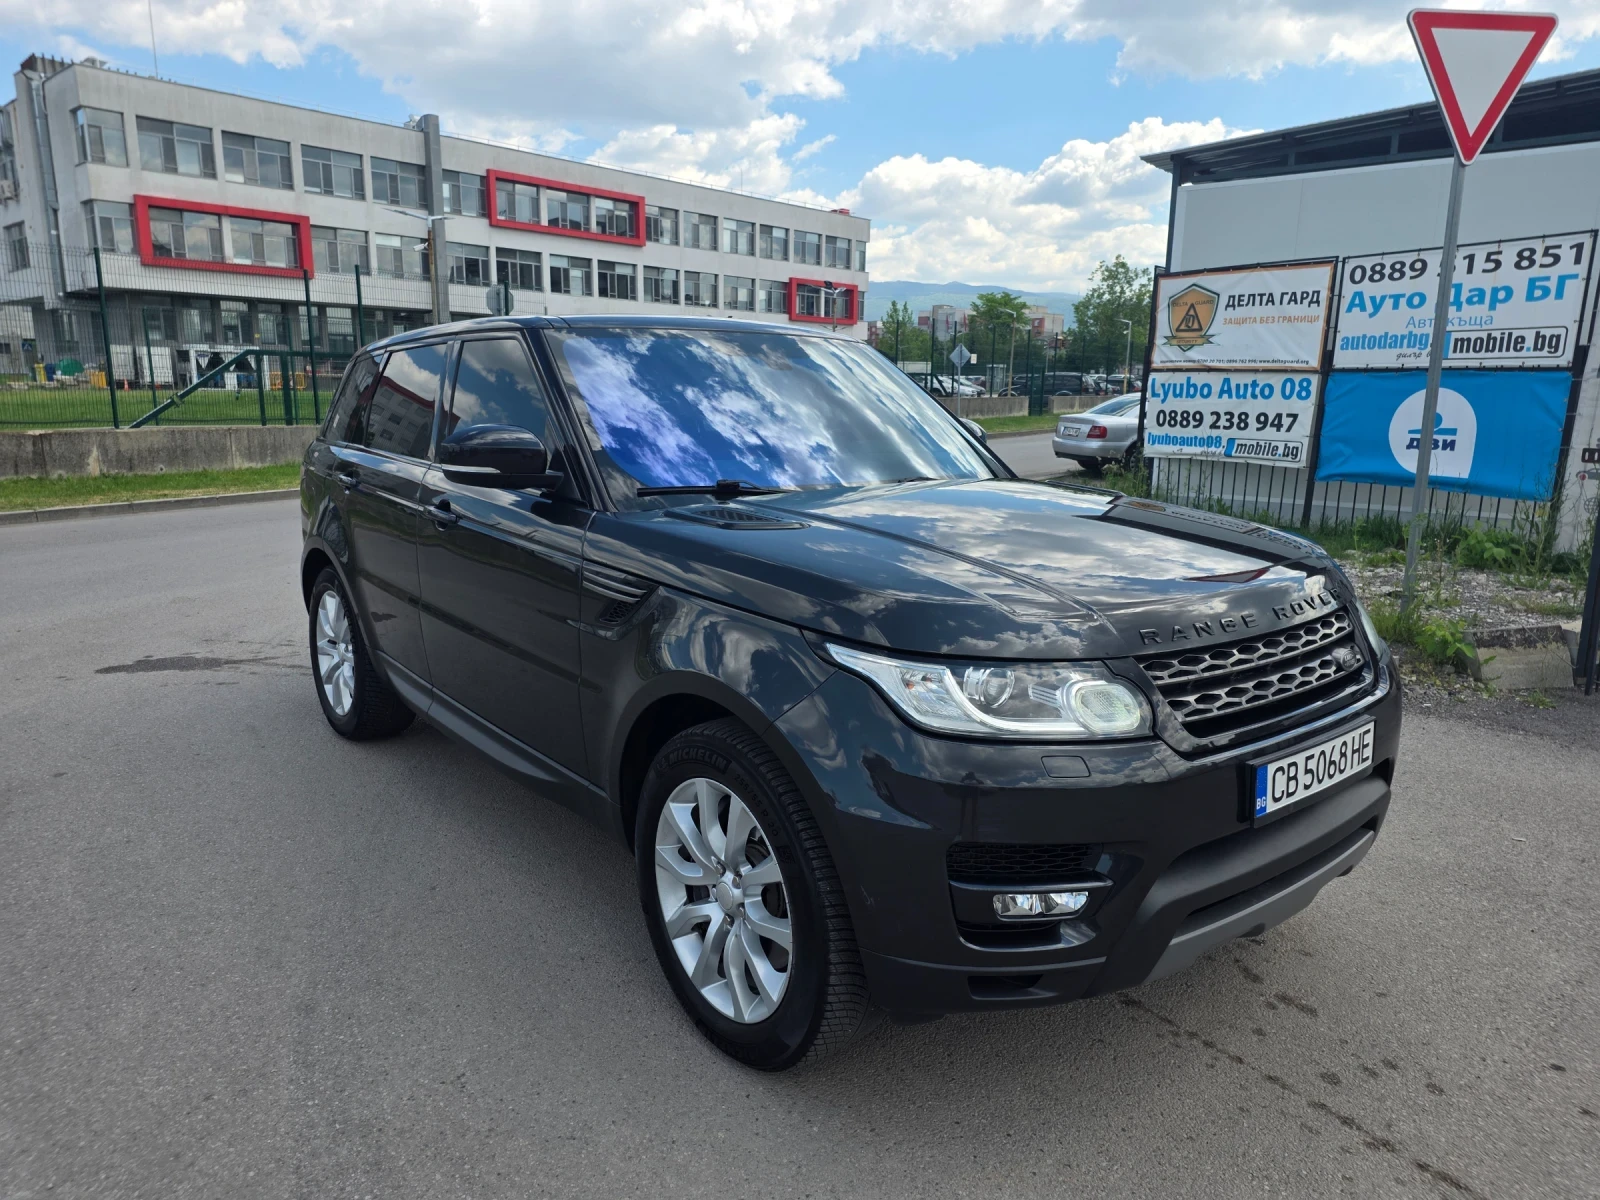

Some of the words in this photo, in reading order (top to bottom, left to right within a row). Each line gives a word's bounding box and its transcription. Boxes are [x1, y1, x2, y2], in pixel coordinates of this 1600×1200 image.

[1349, 258, 1428, 285] 0889
[1437, 250, 1503, 278] 15
[1513, 242, 1585, 271] 851
[1225, 292, 1276, 311] ДЕЛТА
[1279, 290, 1322, 308] ГАРД
[1345, 290, 1427, 318] Ауто
[1525, 273, 1580, 303] БГ
[1222, 316, 1258, 326] ЗАЩИТА
[1259, 315, 1276, 325] БЕЗ
[1277, 314, 1320, 325] ГРАНИЦИ
[1452, 330, 1562, 355] mobile.bg
[1151, 376, 1213, 404] Lyubo
[1217, 377, 1275, 400] Auto
[1281, 377, 1312, 401] 08
[1156, 409, 1204, 429] 0889
[1209, 411, 1250, 431] 238
[1255, 412, 1299, 433] 947
[1234, 441, 1300, 460] mobile.bg
[1139, 612, 1260, 646] RANGE
[1271, 587, 1343, 621] ROVER
[669, 747, 727, 770] MICHELIN
[1271, 764, 1299, 804] CB
[1303, 740, 1348, 791] 5068
[1351, 728, 1372, 771] HE
[1256, 796, 1267, 810] BG
